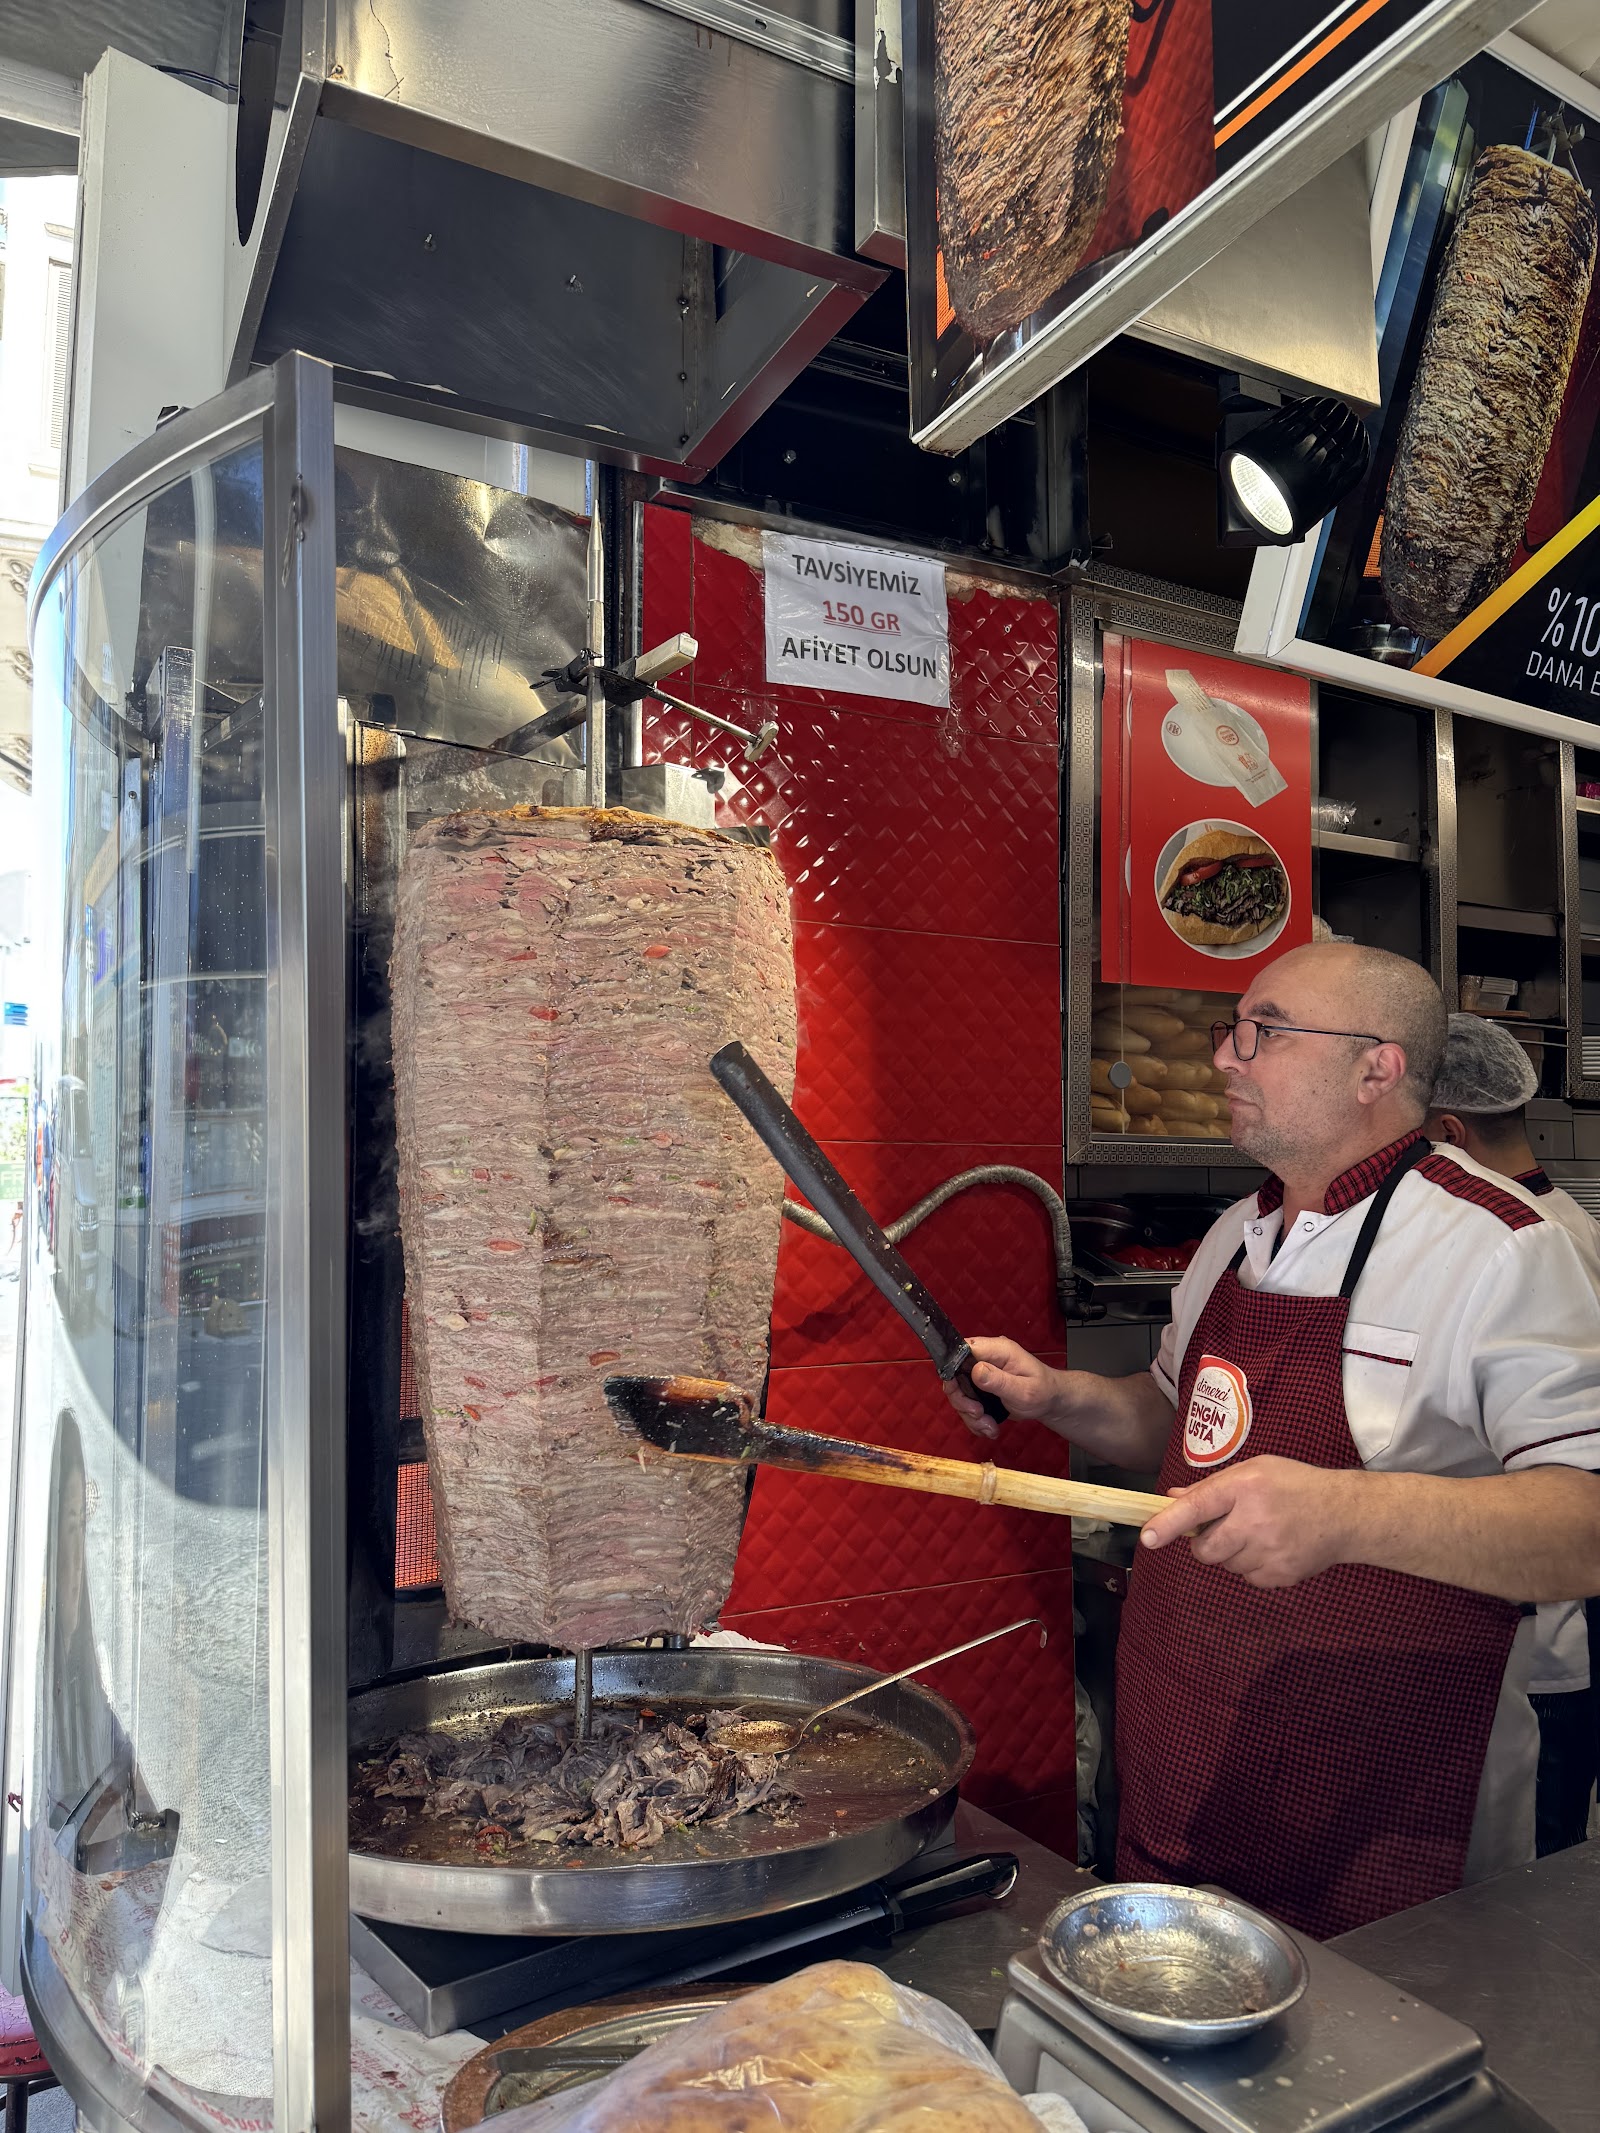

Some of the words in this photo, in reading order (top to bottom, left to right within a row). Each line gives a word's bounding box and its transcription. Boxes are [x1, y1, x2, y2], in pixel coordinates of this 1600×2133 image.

[792, 554, 921, 596] TAVSİYEMİZ
[823, 600, 864, 626] 150
[871, 612, 901, 631] GR
[782, 635, 860, 666] AFİYET
[867, 649, 937, 679] OLSUN
[1526, 650, 1584, 691] DANA
[1188, 1418, 1214, 1445] USTA
[1191, 1401, 1226, 1430] ENGİN
